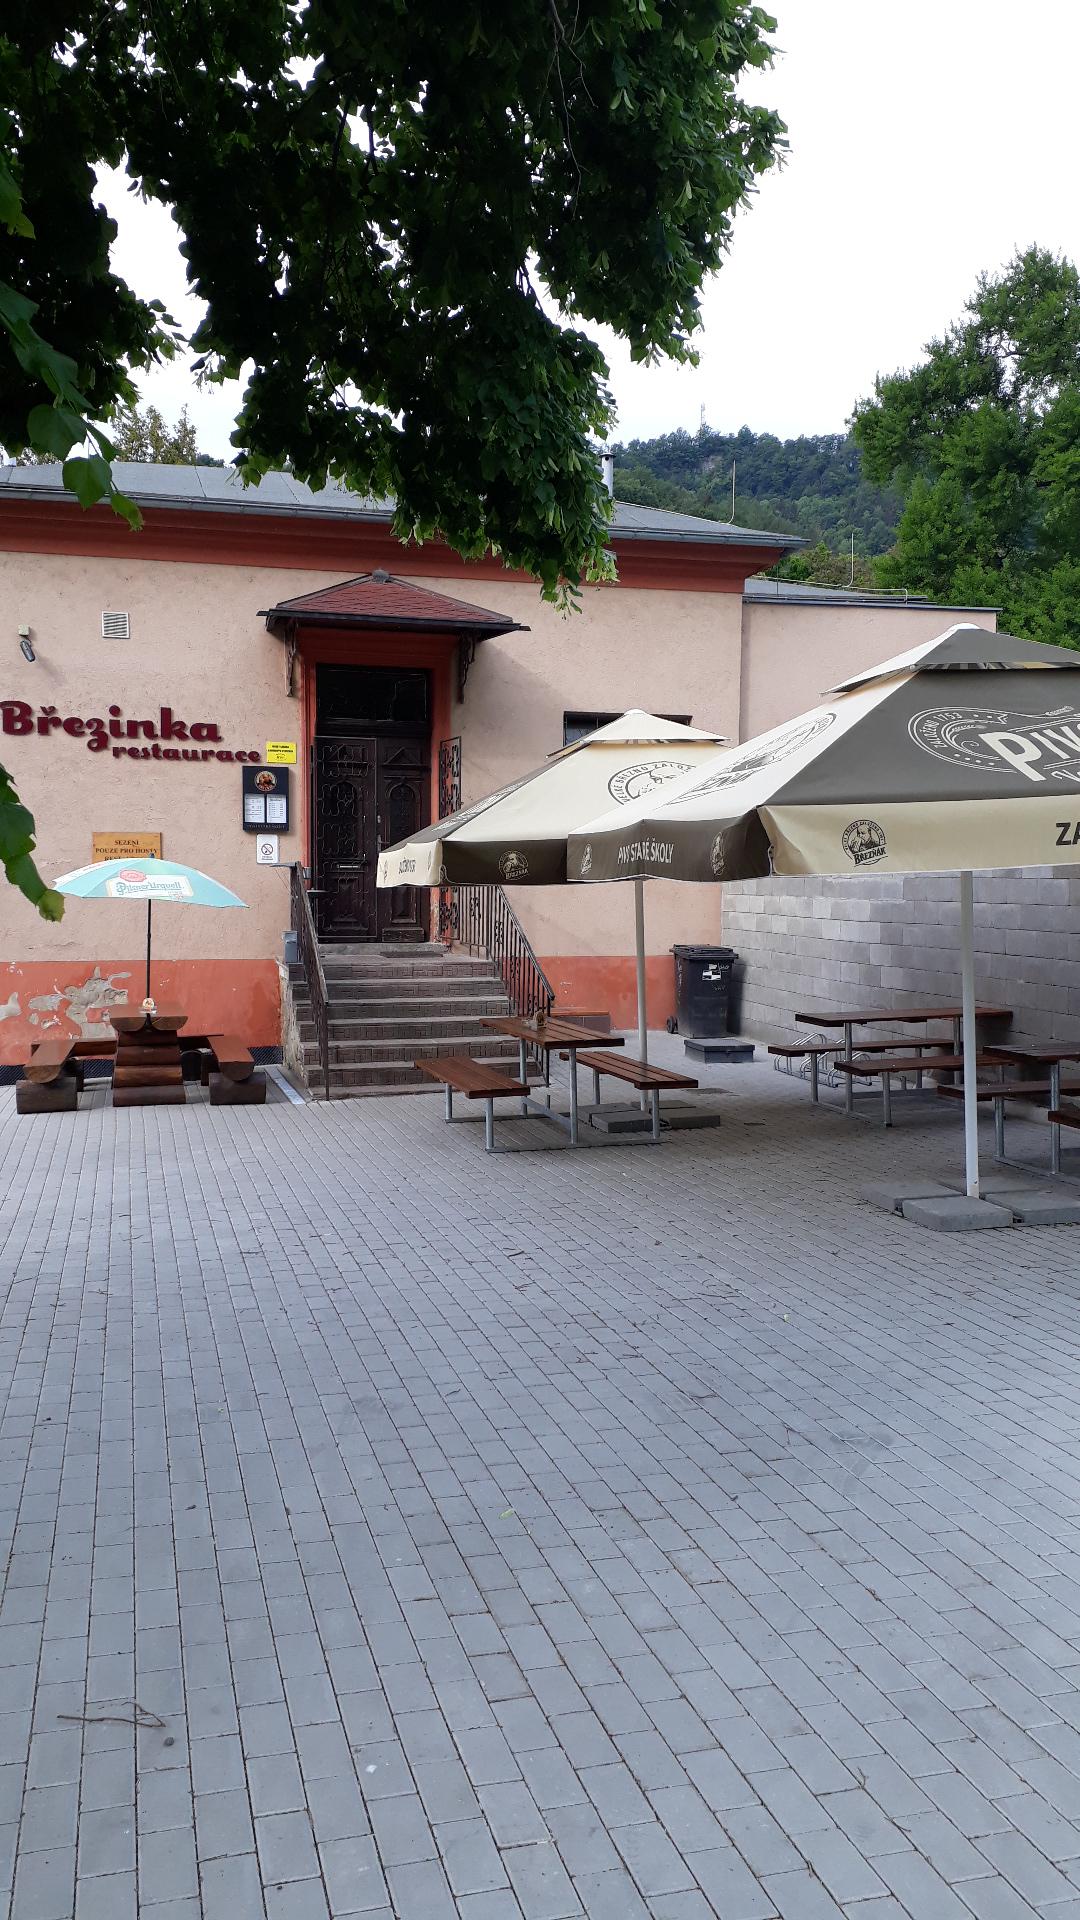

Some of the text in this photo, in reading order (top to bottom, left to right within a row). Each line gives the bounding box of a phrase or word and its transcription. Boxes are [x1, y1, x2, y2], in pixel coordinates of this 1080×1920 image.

[0, 700, 223, 752] Březinka
[932, 712, 963, 722] 1753
[112, 743, 261, 762] restaurace
[650, 837, 674, 864] ŠKOLY
[116, 881, 183, 896] Pilsner Urquell
